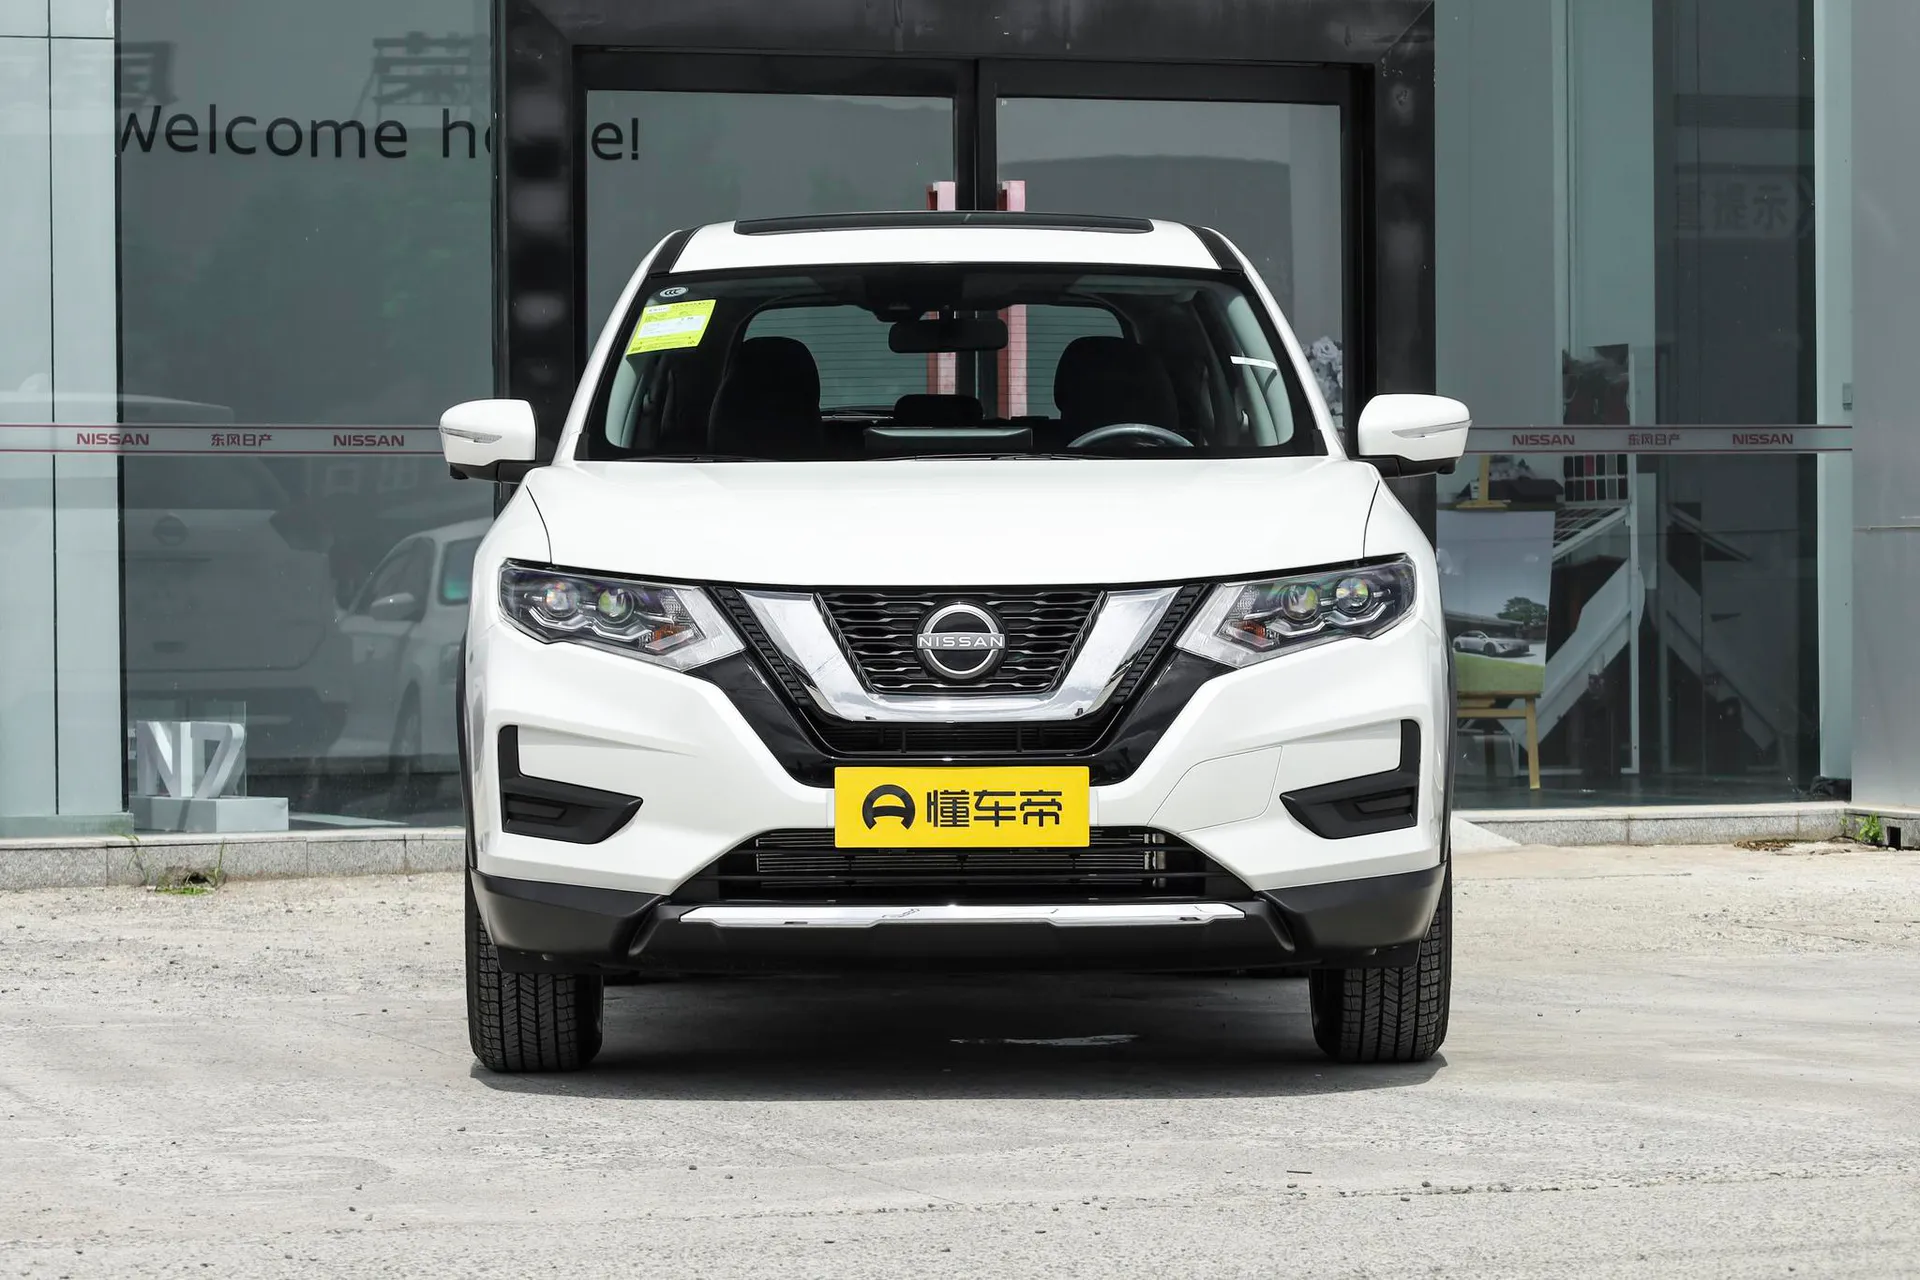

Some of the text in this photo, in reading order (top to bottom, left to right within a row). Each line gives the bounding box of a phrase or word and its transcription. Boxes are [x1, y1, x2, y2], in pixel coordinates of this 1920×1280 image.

[120, 103, 640, 161] Welcome he!
[76, 432, 150, 446] NISSAN
[210, 433, 273, 447] 东风日产
[332, 434, 406, 447] NISSAN
[1511, 434, 1576, 446] NISSAN
[1627, 433, 1681, 446] 东风日产
[1731, 433, 1794, 445] NISSAN
[919, 636, 1004, 648] NISSAN
[926, 789, 1063, 828] 懂车帝
